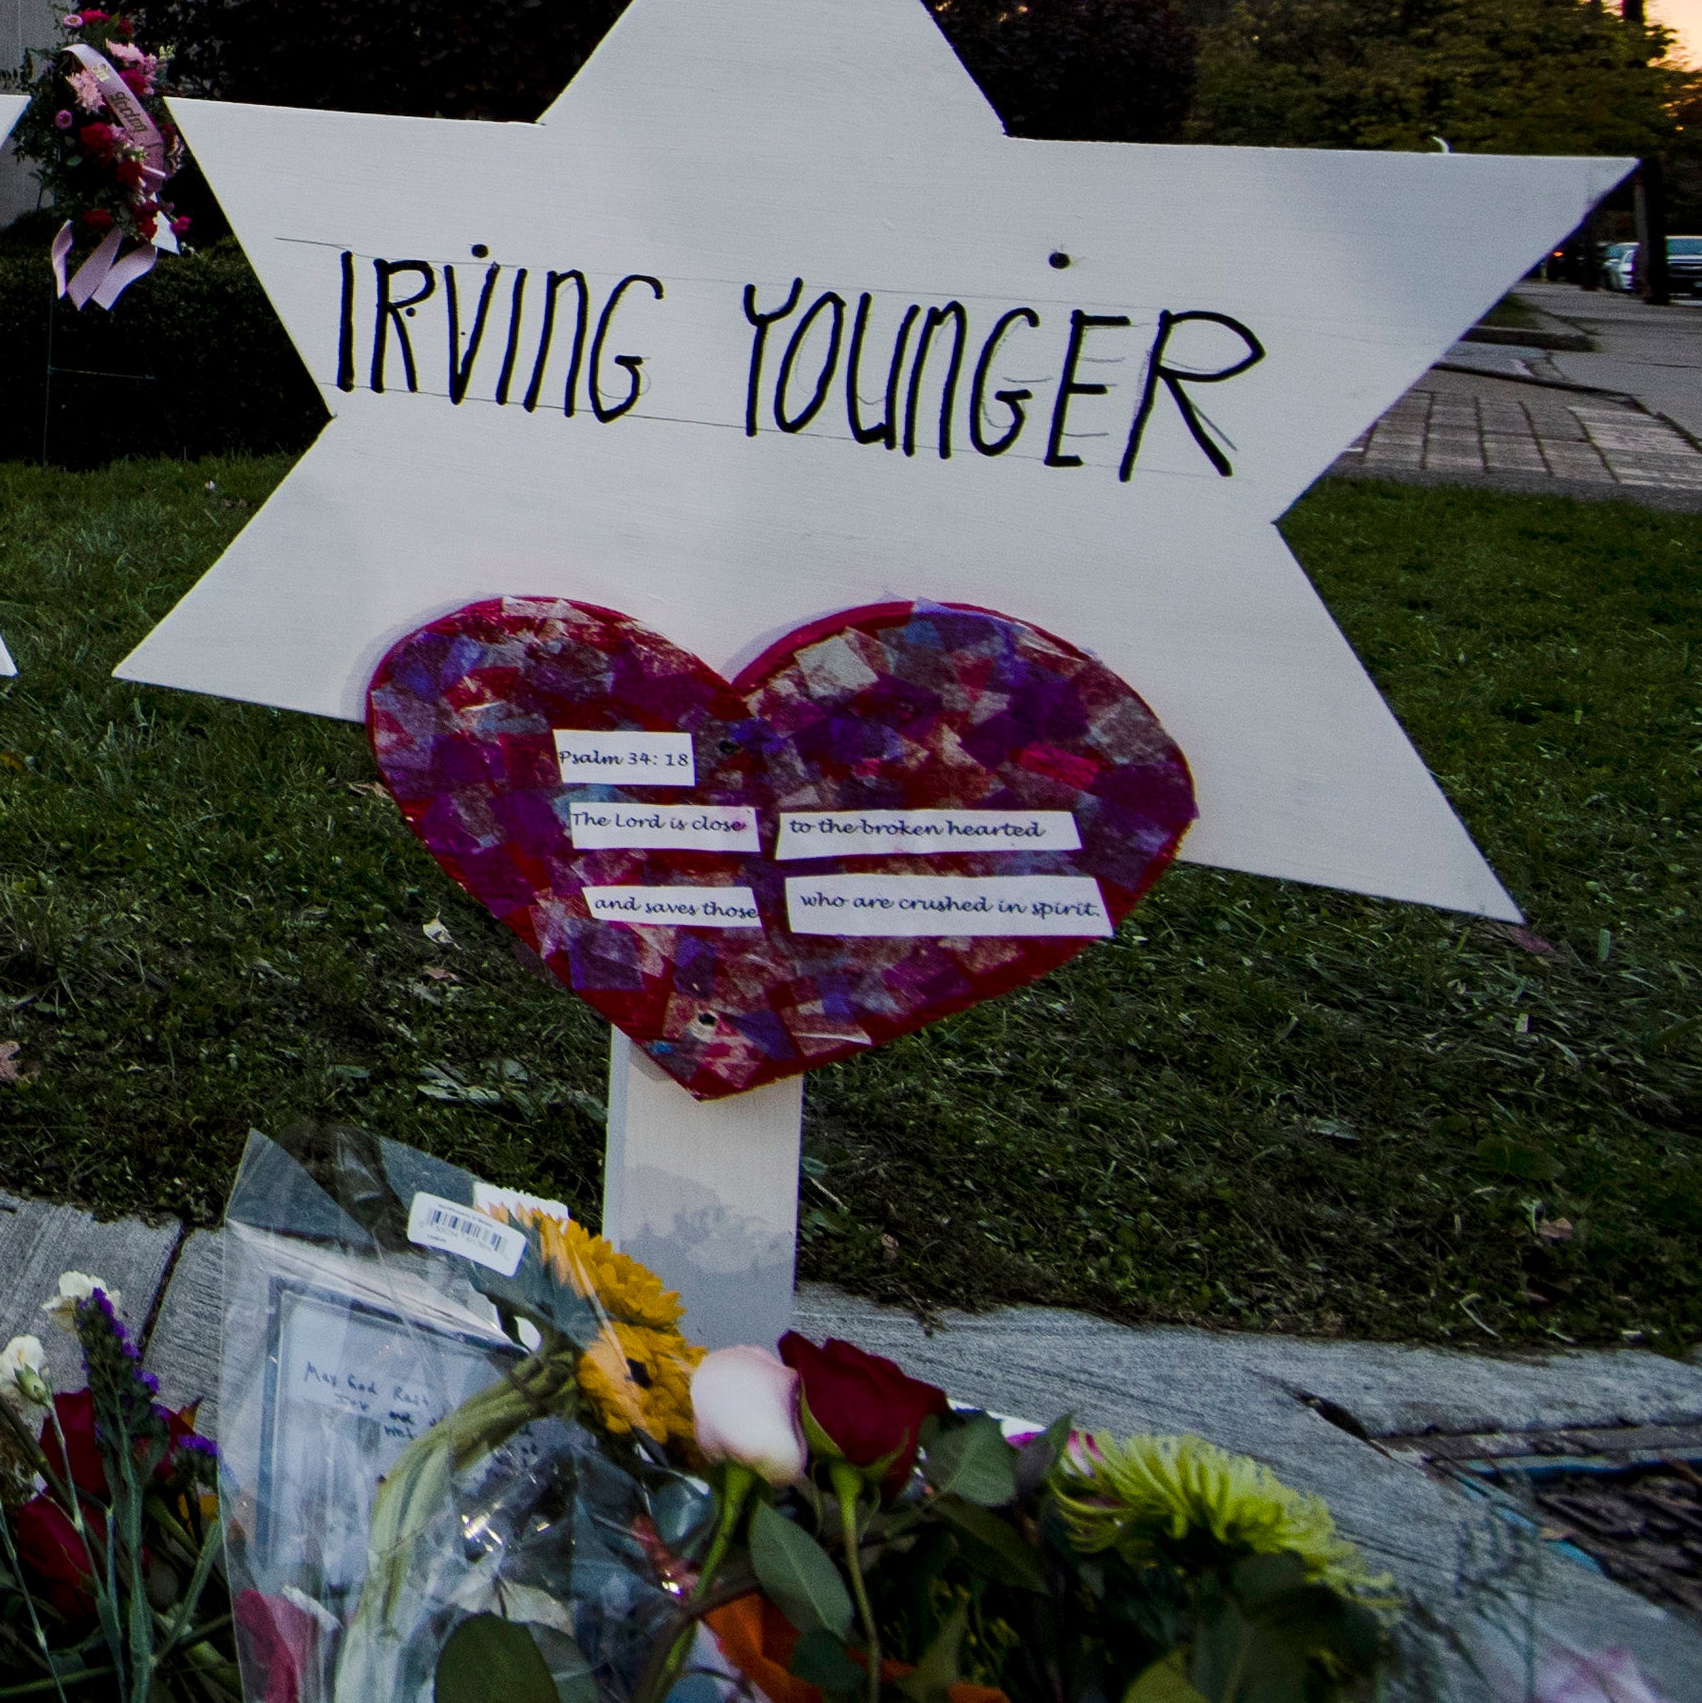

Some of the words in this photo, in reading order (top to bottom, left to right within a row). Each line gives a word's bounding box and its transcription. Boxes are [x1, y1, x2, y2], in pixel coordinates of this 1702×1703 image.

[337, 250, 664, 423] IRVING
[743, 278, 1265, 482] YOUNGER
[559, 749, 624, 766] Psalm
[627, 751, 658, 766] 34:
[666, 753, 689, 767] 18
[572, 811, 610, 827] The
[615, 812, 665, 829] Lord
[669, 817, 687, 830] is
[691, 815, 746, 832] close
[789, 818, 815, 834] to
[818, 817, 859, 834] the
[859, 818, 944, 836] broken
[945, 820, 1046, 838] hearted
[595, 896, 641, 912] and
[645, 901, 697, 916] saves
[702, 901, 759, 919] those
[799, 891, 846, 908] who
[852, 897, 893, 910] are
[898, 895, 992, 914] crushed
[997, 900, 1028, 914] in
[1031, 901, 1101, 919] spirit.
